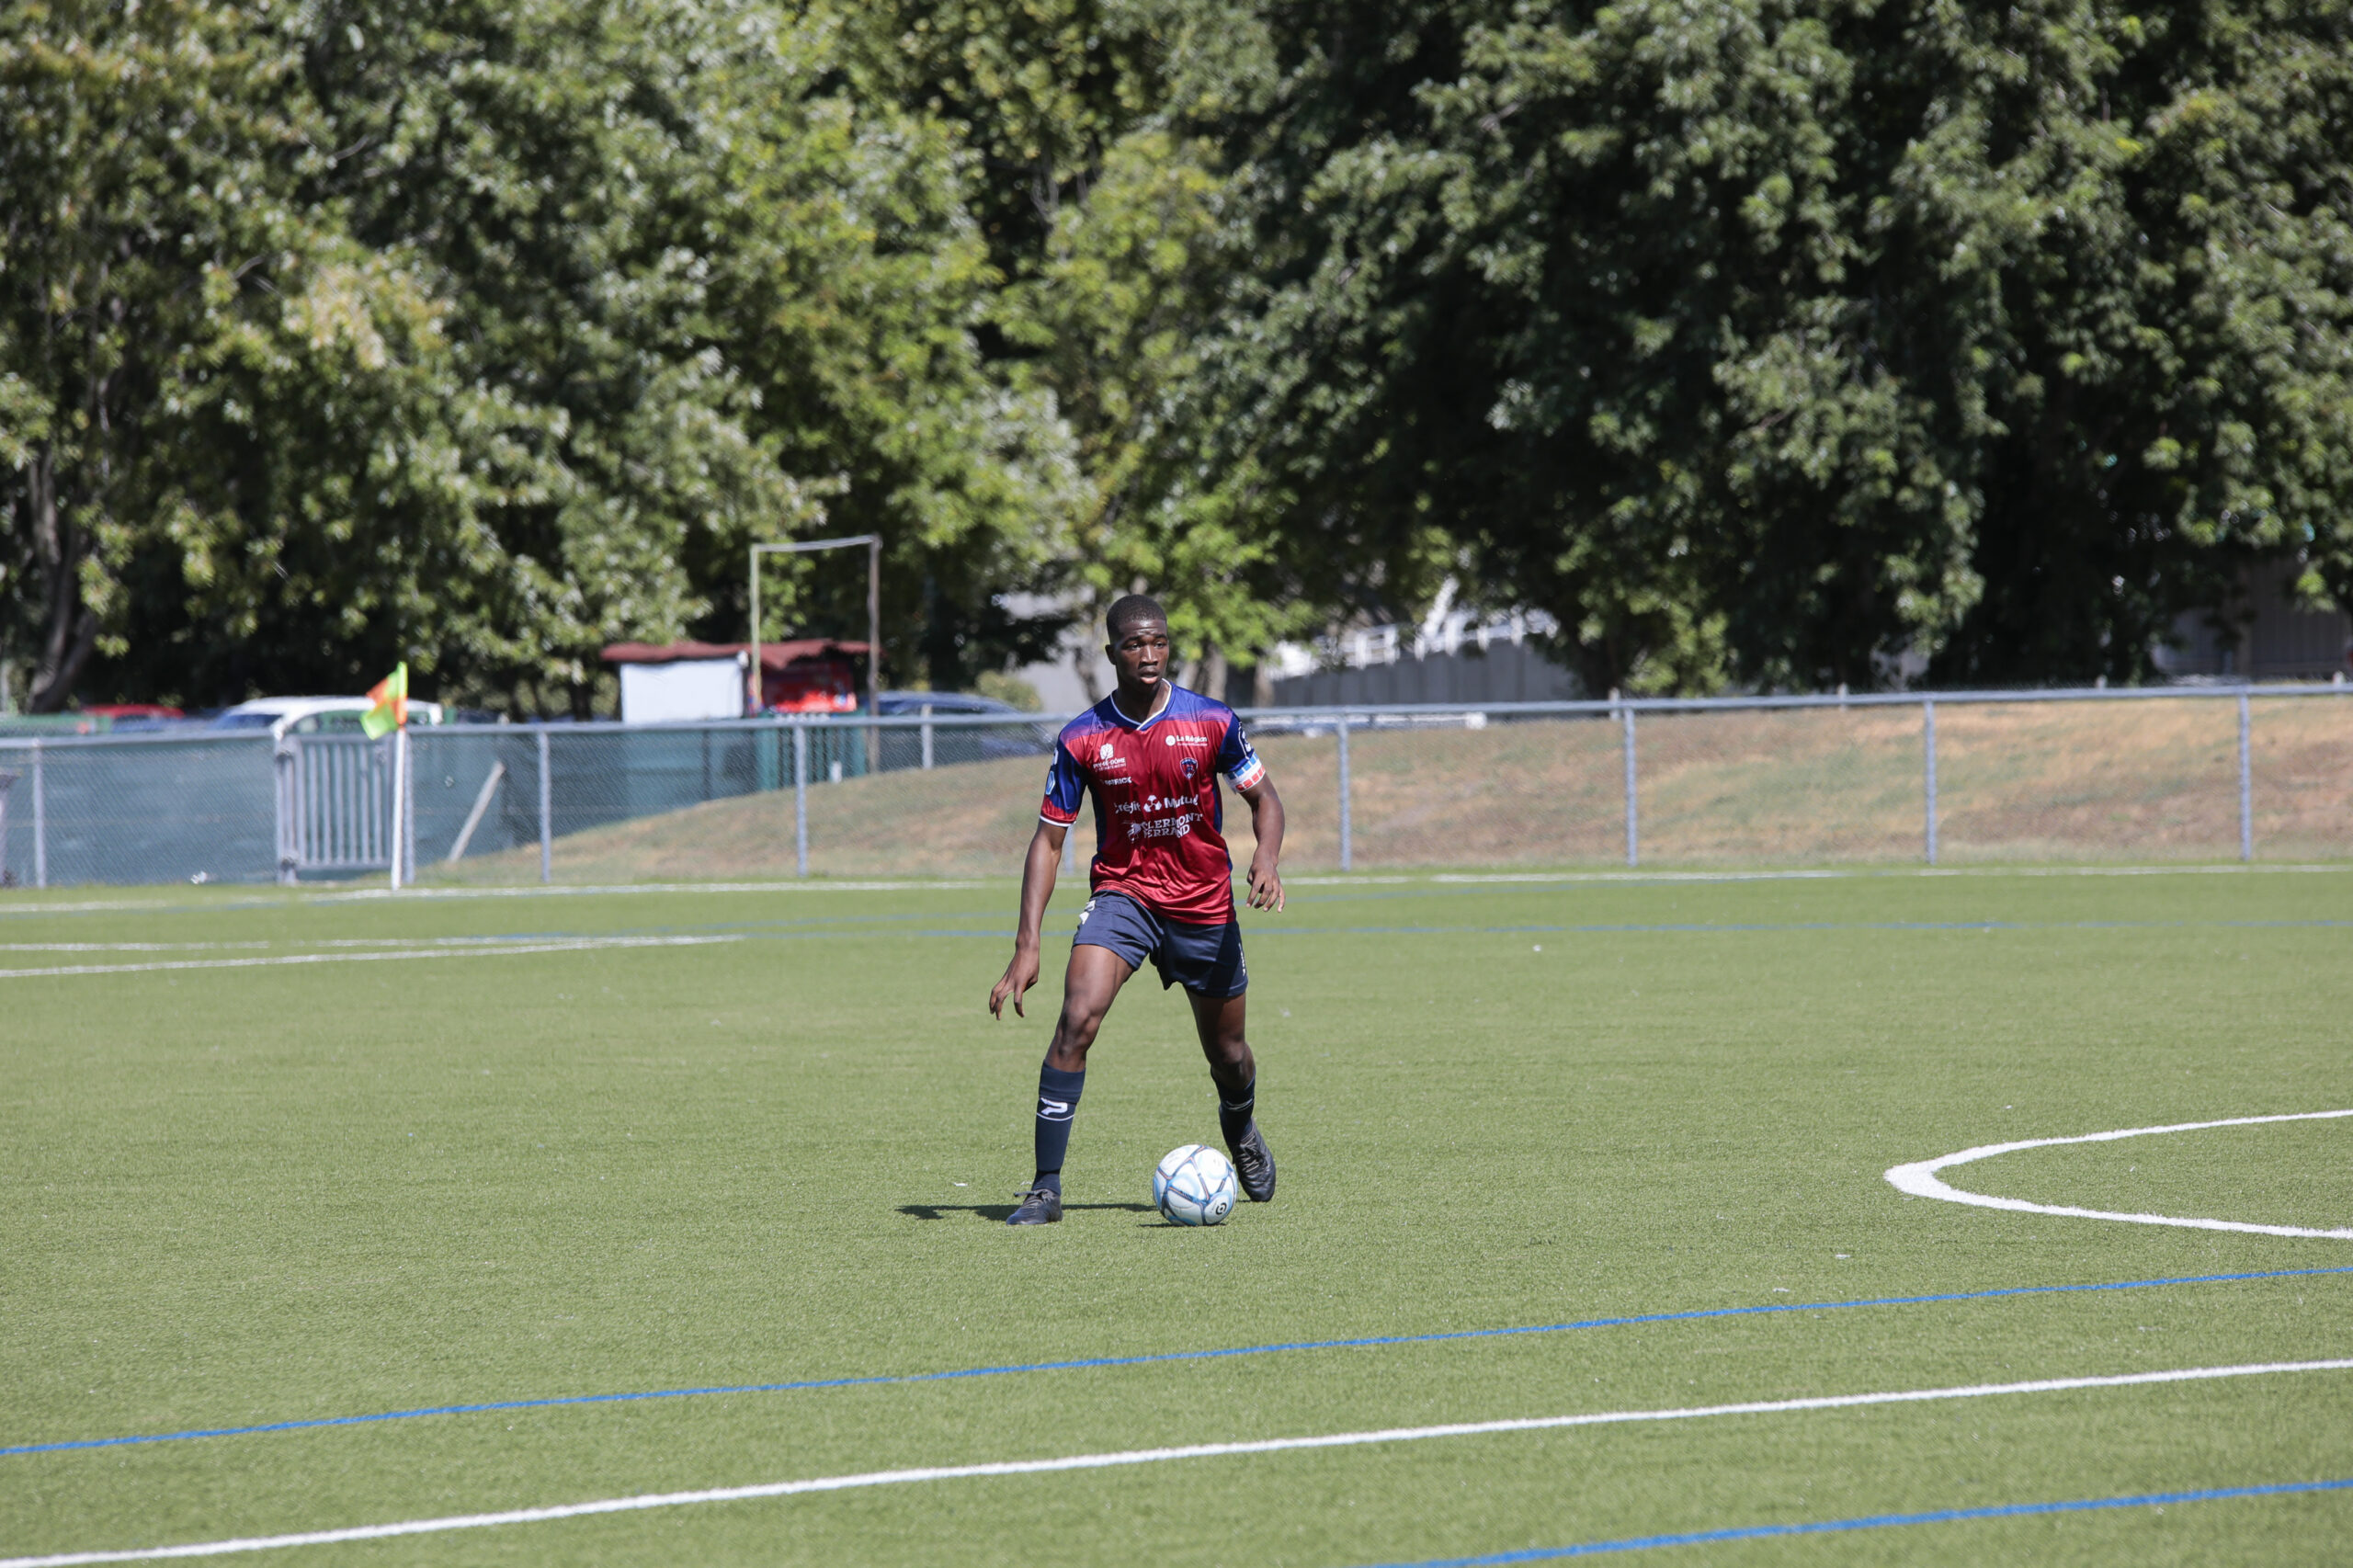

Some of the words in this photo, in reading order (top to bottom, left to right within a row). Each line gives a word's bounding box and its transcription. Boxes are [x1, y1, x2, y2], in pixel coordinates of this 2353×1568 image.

[1185, 734, 1208, 743] Région
[1104, 776, 1132, 786] PATRICK
[1141, 812, 1203, 831] CLERMONT
